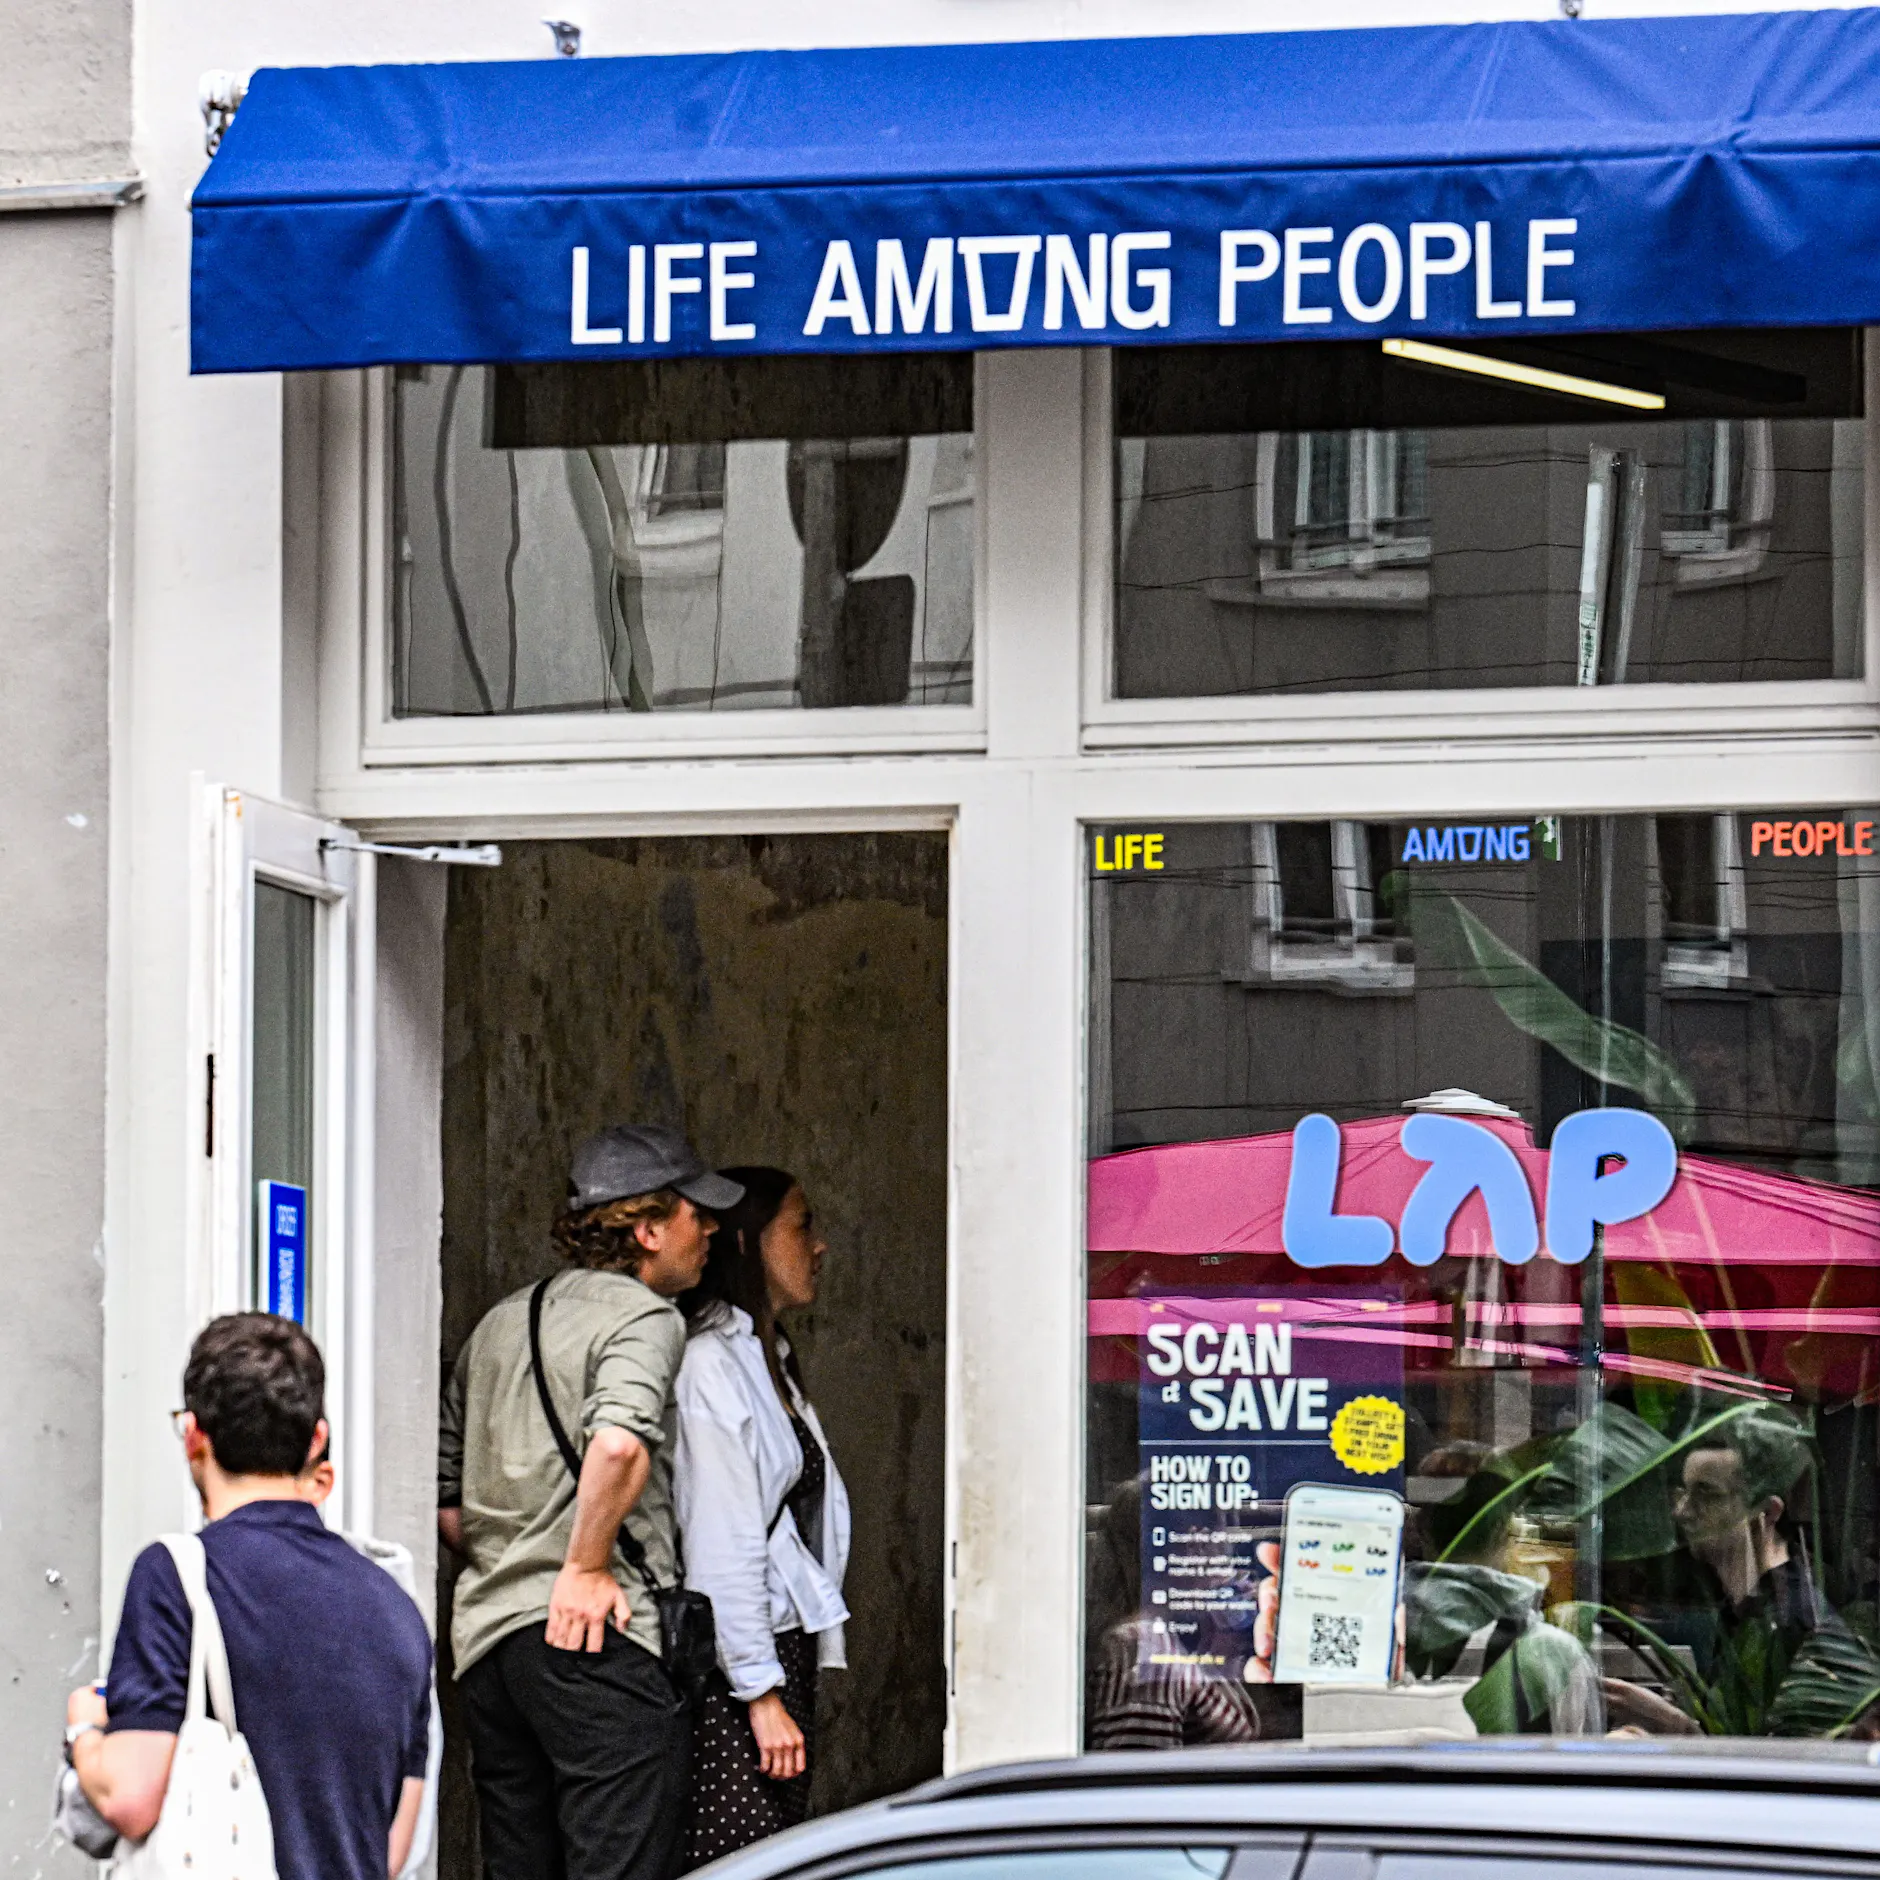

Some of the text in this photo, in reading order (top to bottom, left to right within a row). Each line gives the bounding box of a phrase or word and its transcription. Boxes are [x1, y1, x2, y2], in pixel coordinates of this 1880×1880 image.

[571, 218, 1578, 345] LIFE AMONG PEOPLE
[1095, 821, 1873, 871] LIFE AMONG PEOPLE
[1282, 1106, 1678, 1268] LAP
[1146, 1322, 1293, 1377] SCAN
[1189, 1377, 1329, 1432] SAVE
[1150, 1454, 1251, 1483] HOW TO
[1150, 1482, 1260, 1511] SIGN UP:
